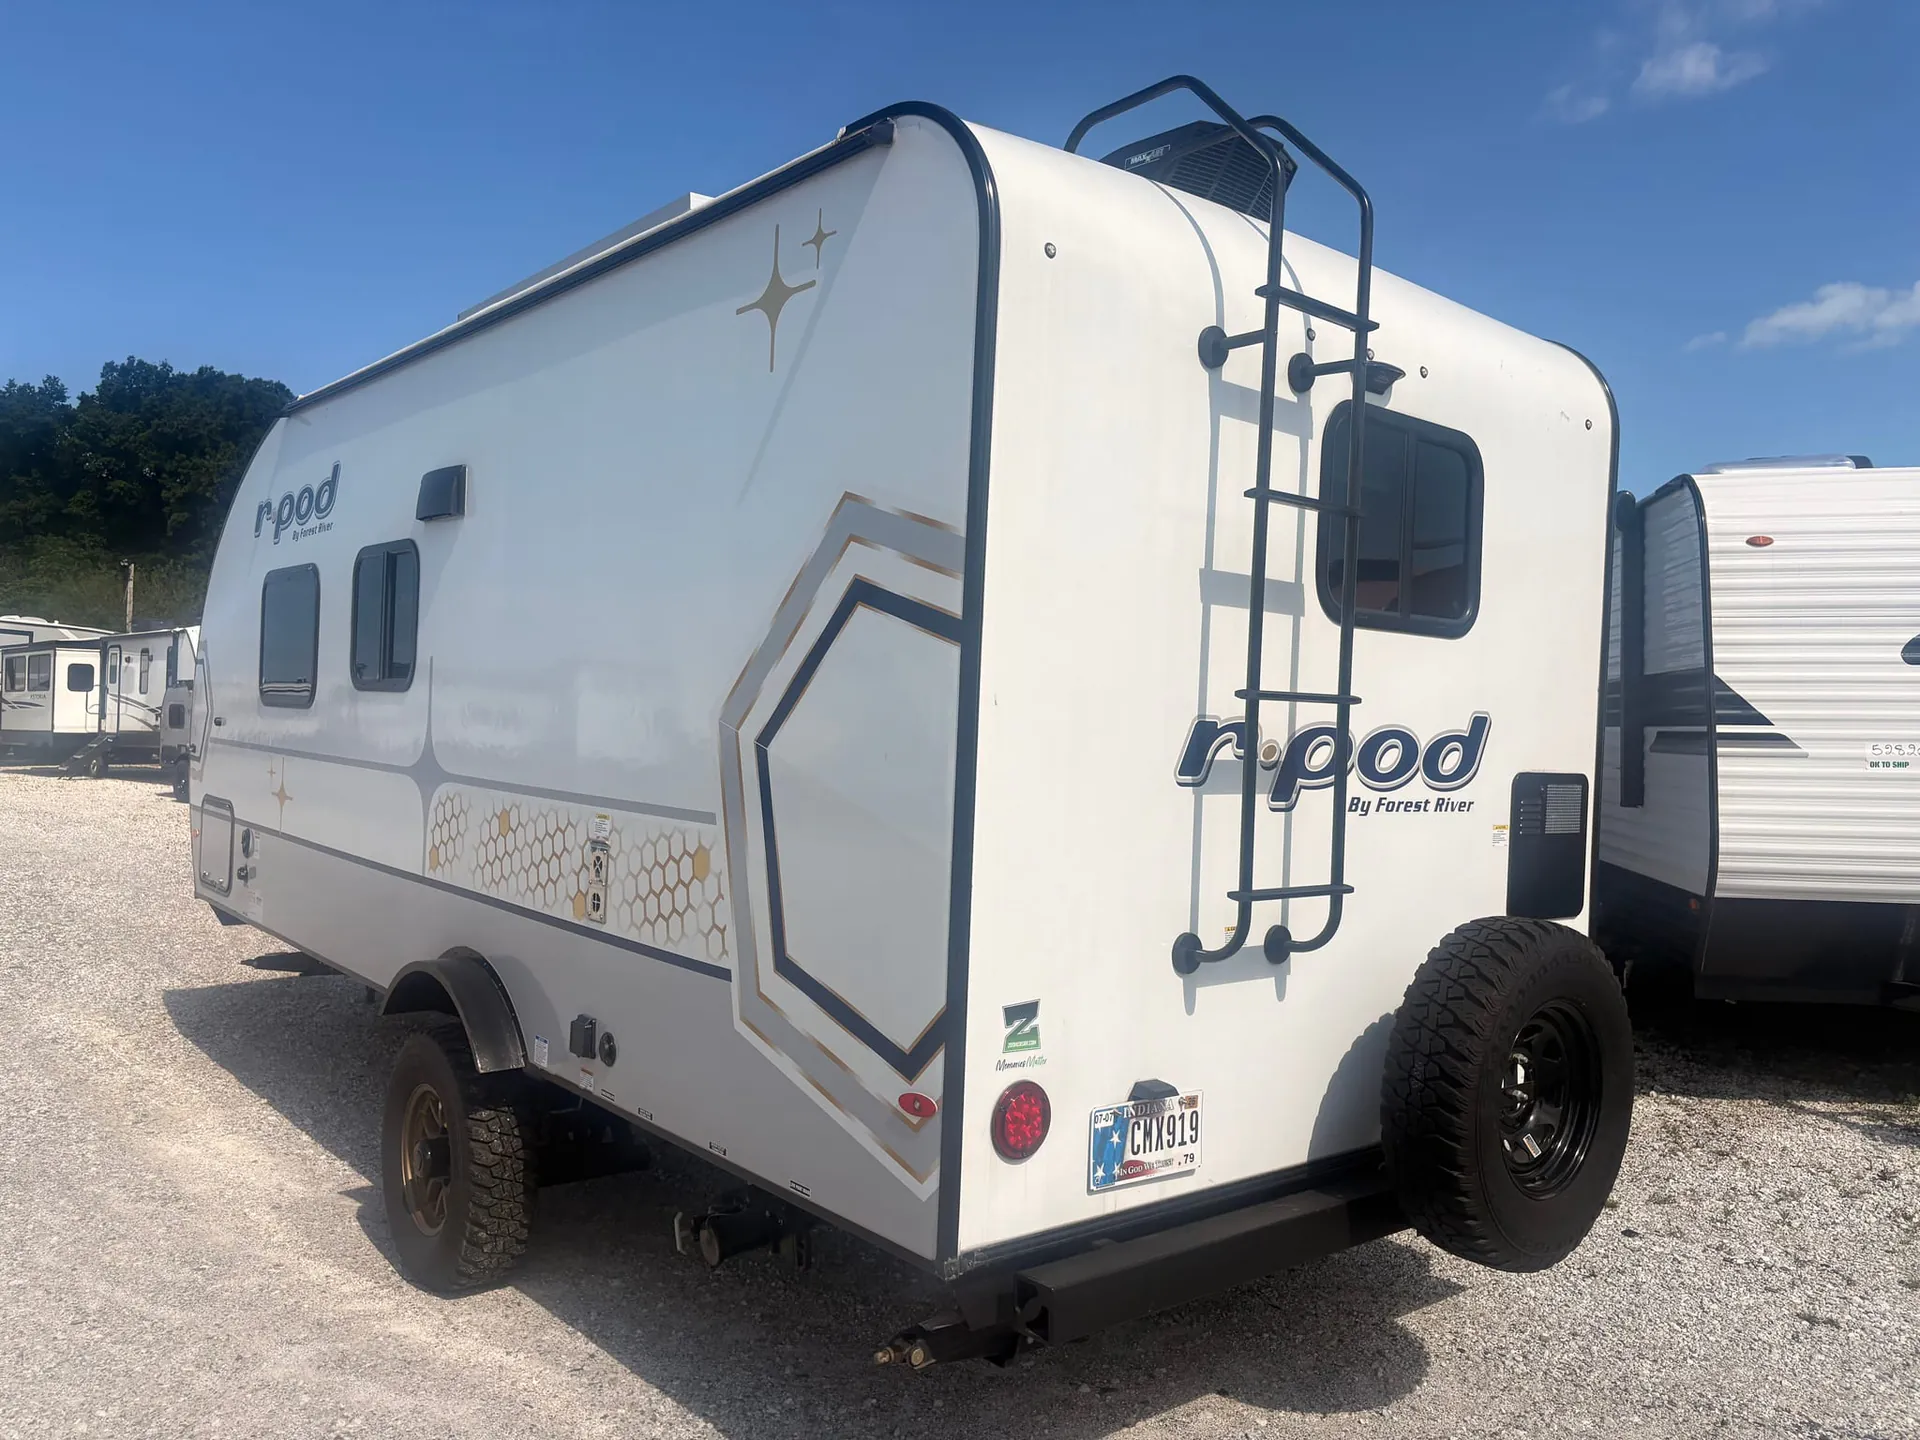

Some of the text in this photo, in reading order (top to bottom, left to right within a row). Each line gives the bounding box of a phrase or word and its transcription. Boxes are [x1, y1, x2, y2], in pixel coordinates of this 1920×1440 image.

[1869, 761, 1910, 769] OK TO SHIP
[1347, 796, 1475, 817] By Forest River
[1123, 1098, 1175, 1119] INDIANA
[1130, 1110, 1199, 1156] CMX919
[1183, 1153, 1195, 1164] 79
